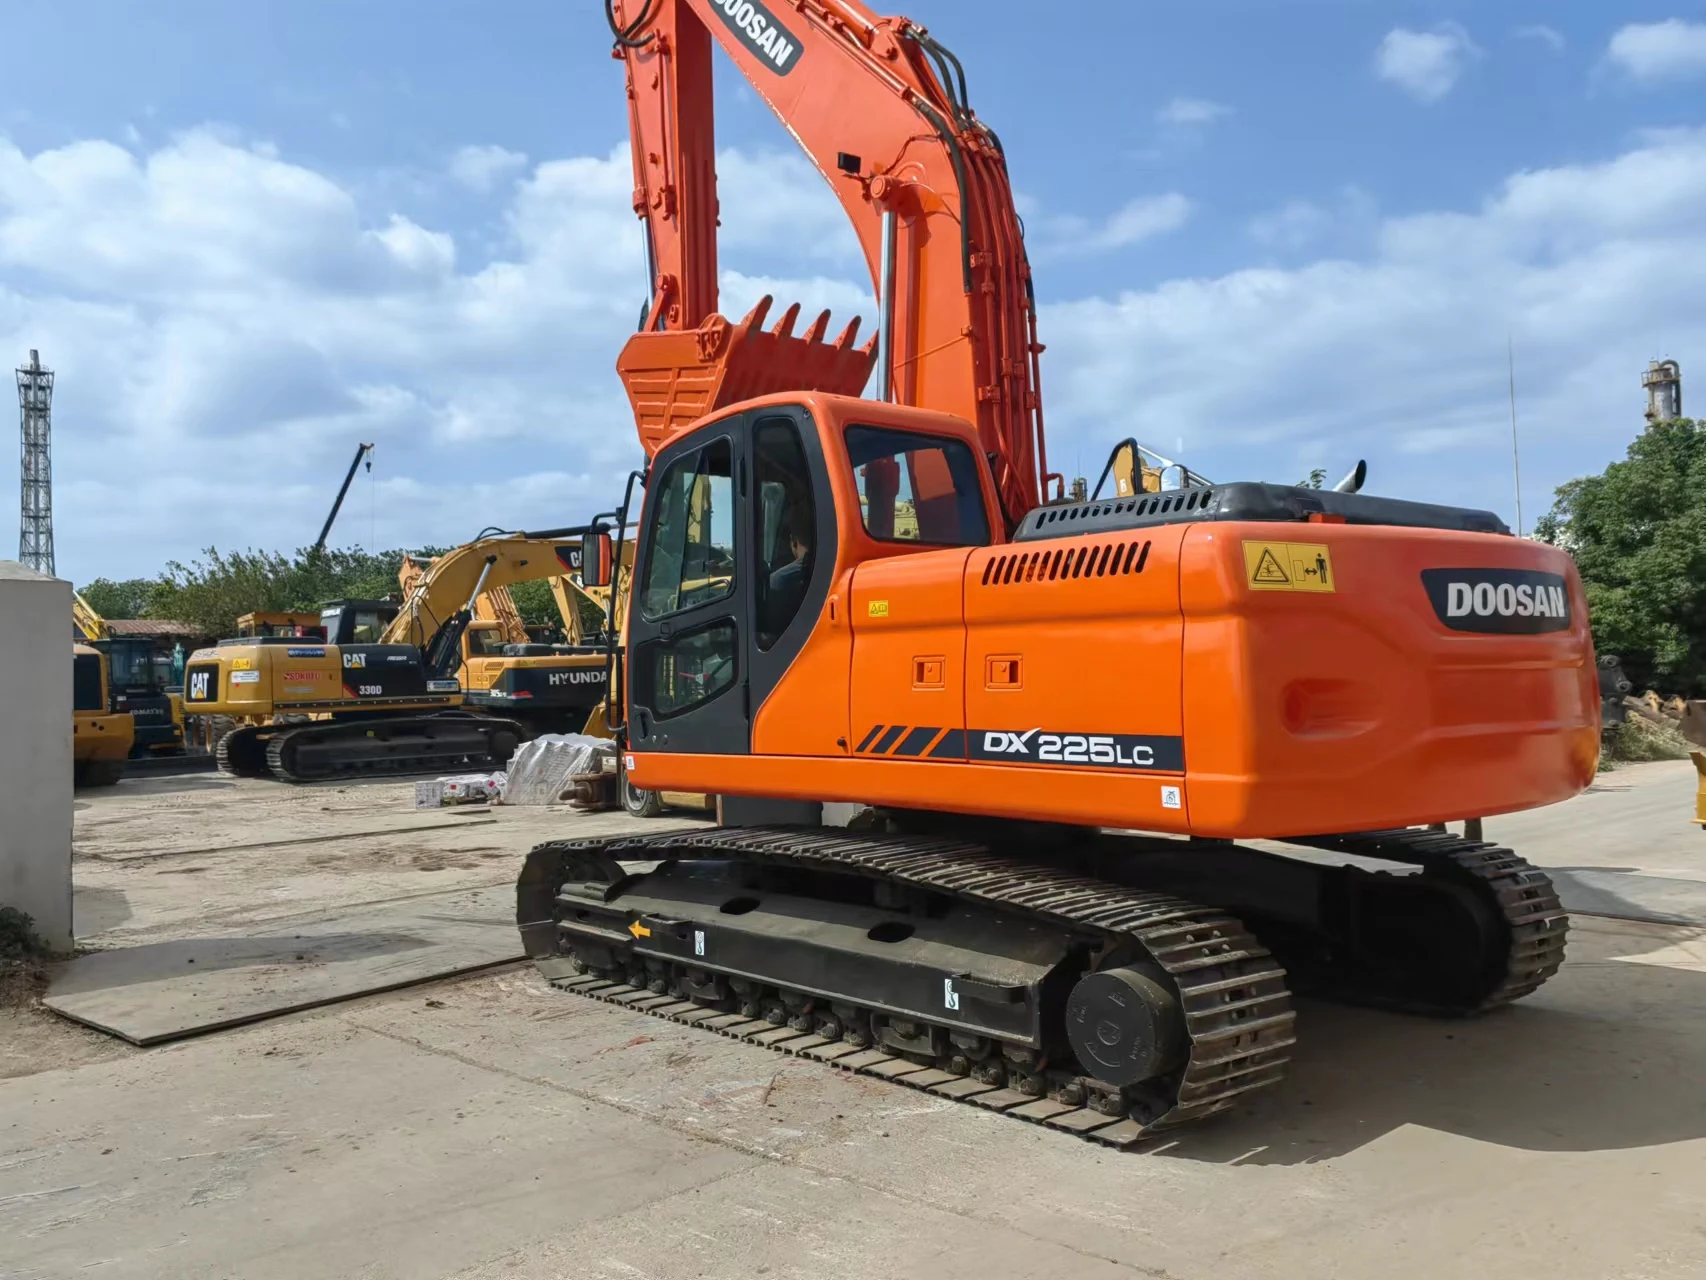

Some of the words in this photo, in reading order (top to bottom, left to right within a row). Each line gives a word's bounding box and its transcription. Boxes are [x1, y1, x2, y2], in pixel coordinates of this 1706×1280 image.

[714, 0, 794, 67] OOSAN
[1447, 582, 1565, 617] DOOSAN
[343, 653, 366, 668] CAT
[191, 672, 209, 699] CAT
[548, 671, 607, 686] HYUNDA
[359, 685, 382, 695] 330D
